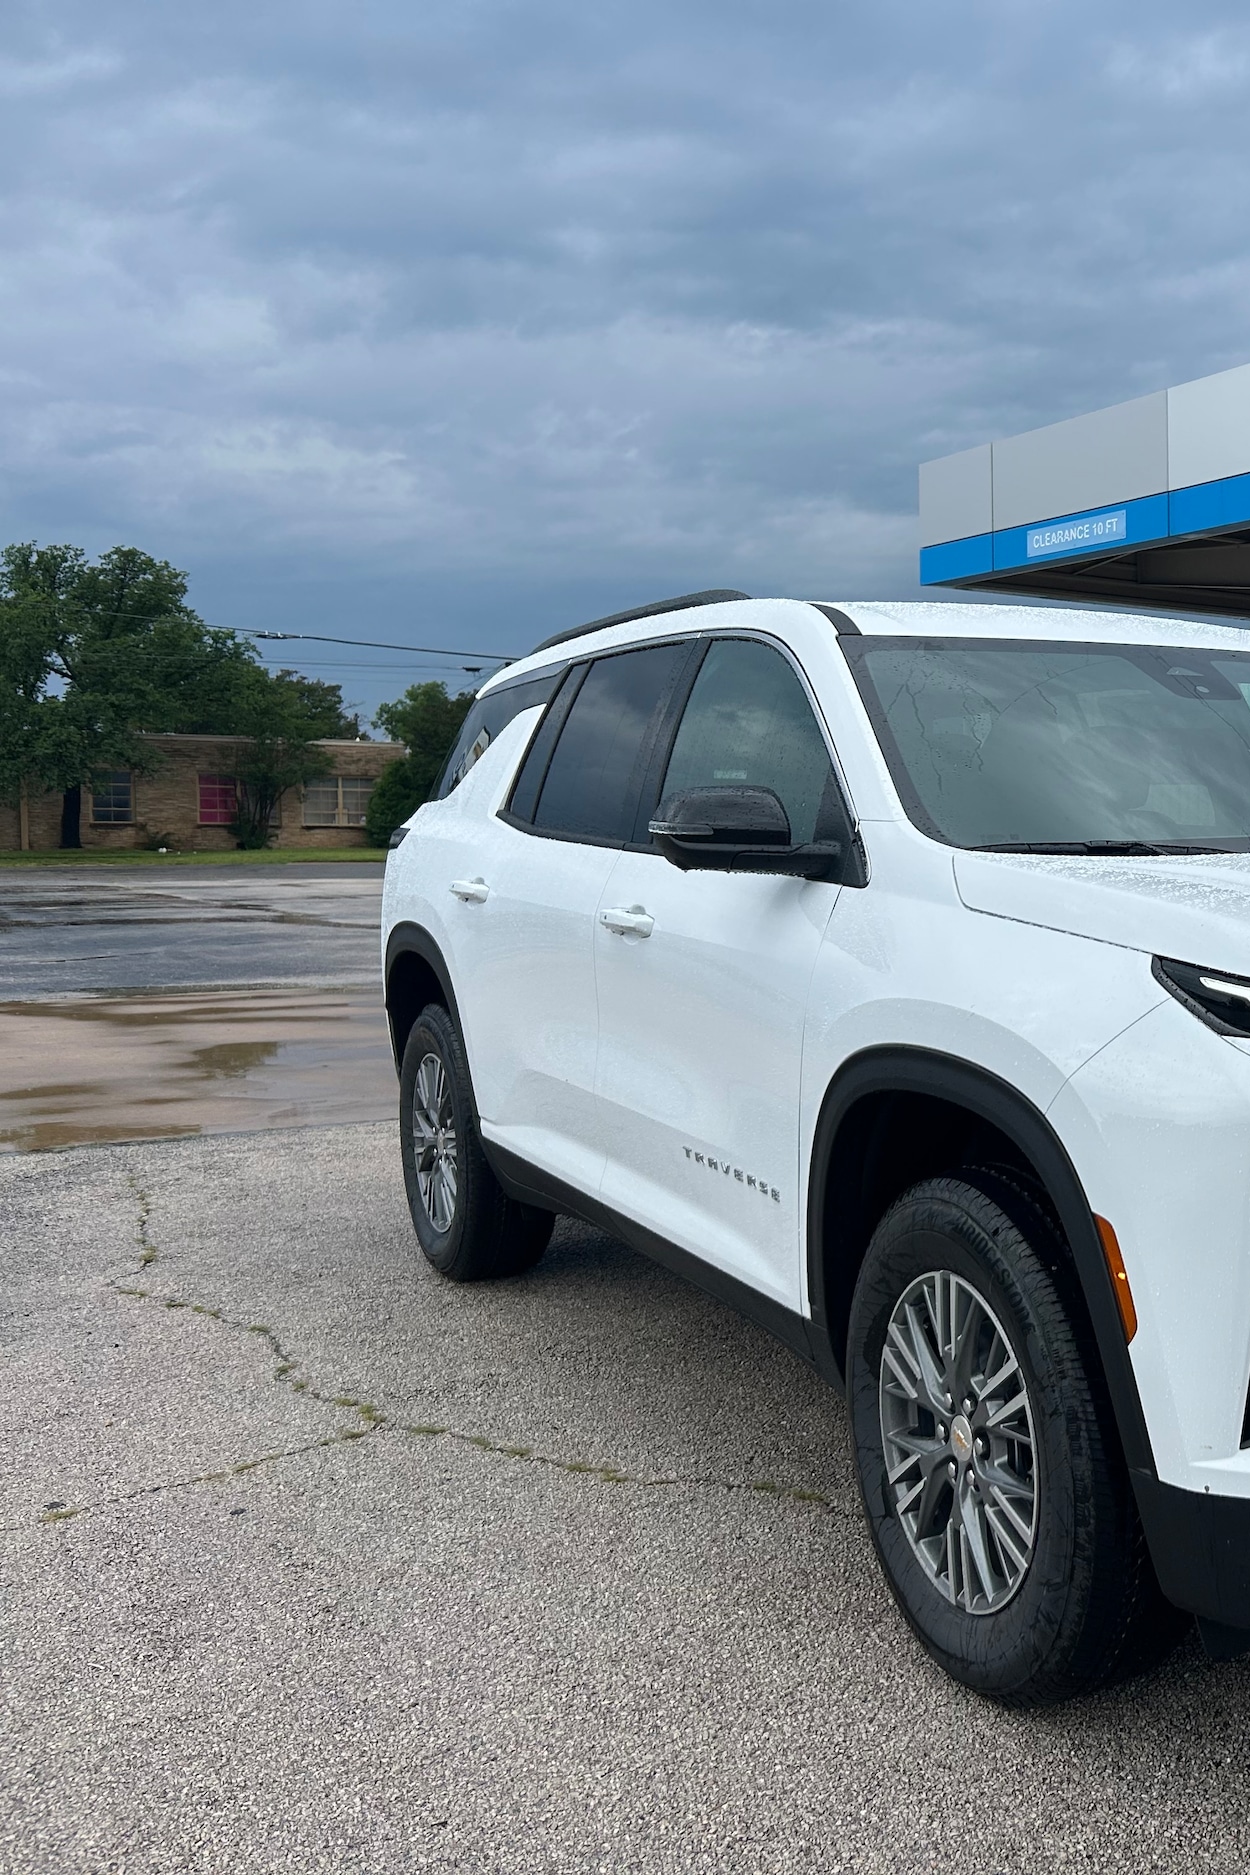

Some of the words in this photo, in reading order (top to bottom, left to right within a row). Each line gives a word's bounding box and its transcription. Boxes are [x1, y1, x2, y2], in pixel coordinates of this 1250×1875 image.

[1033, 524, 1090, 548] CLEARANCE
[1092, 521, 1104, 536] 10
[1105, 518, 1118, 533] FT
[682, 1145, 781, 1203] TRAVERSE
